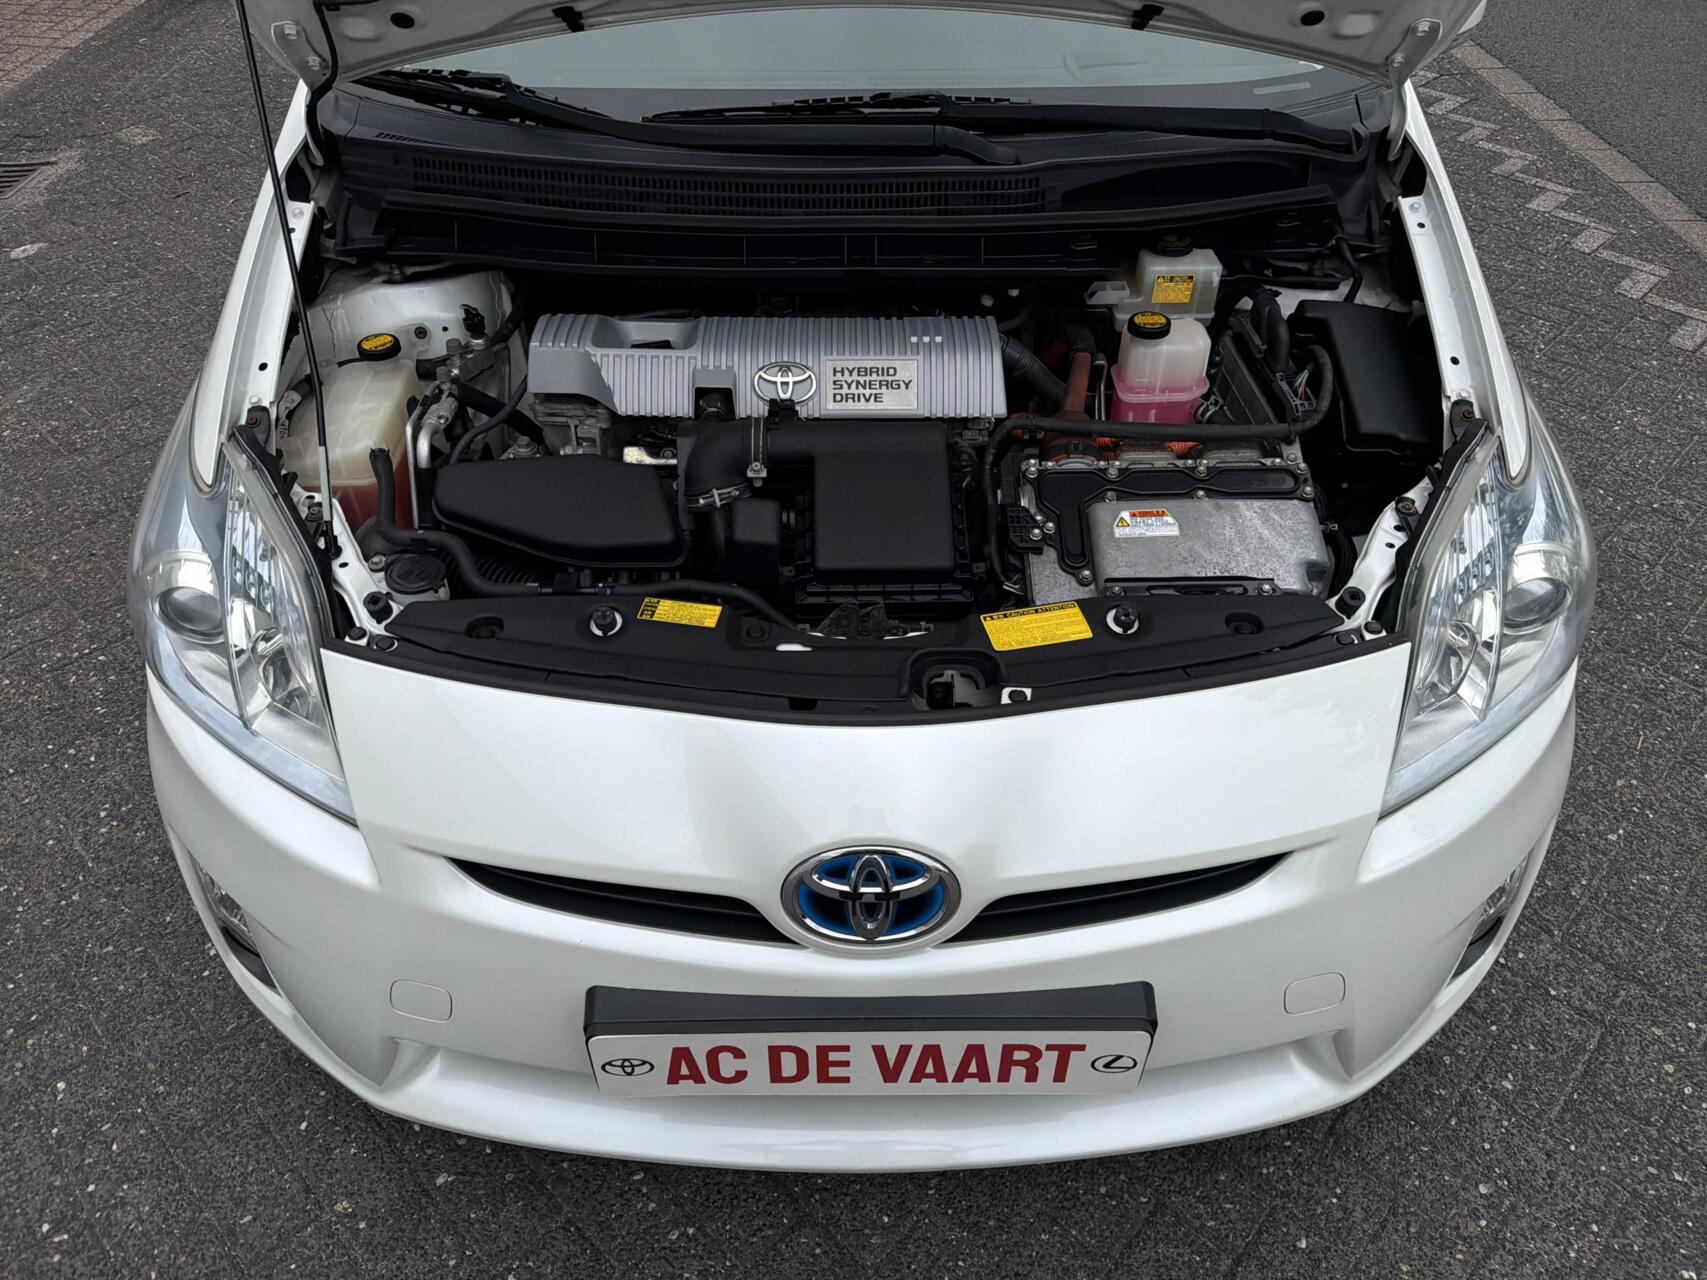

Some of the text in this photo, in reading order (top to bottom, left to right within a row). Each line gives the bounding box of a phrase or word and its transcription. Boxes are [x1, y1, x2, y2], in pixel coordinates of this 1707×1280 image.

[832, 366, 897, 377] HYBRID
[832, 379, 912, 391] SYNERGY
[832, 393, 884, 403] DRIVE
[1006, 608, 1036, 618] CAUTION
[1037, 603, 1075, 614] ATTENTION
[666, 1043, 1086, 1085] AC DE VAART
